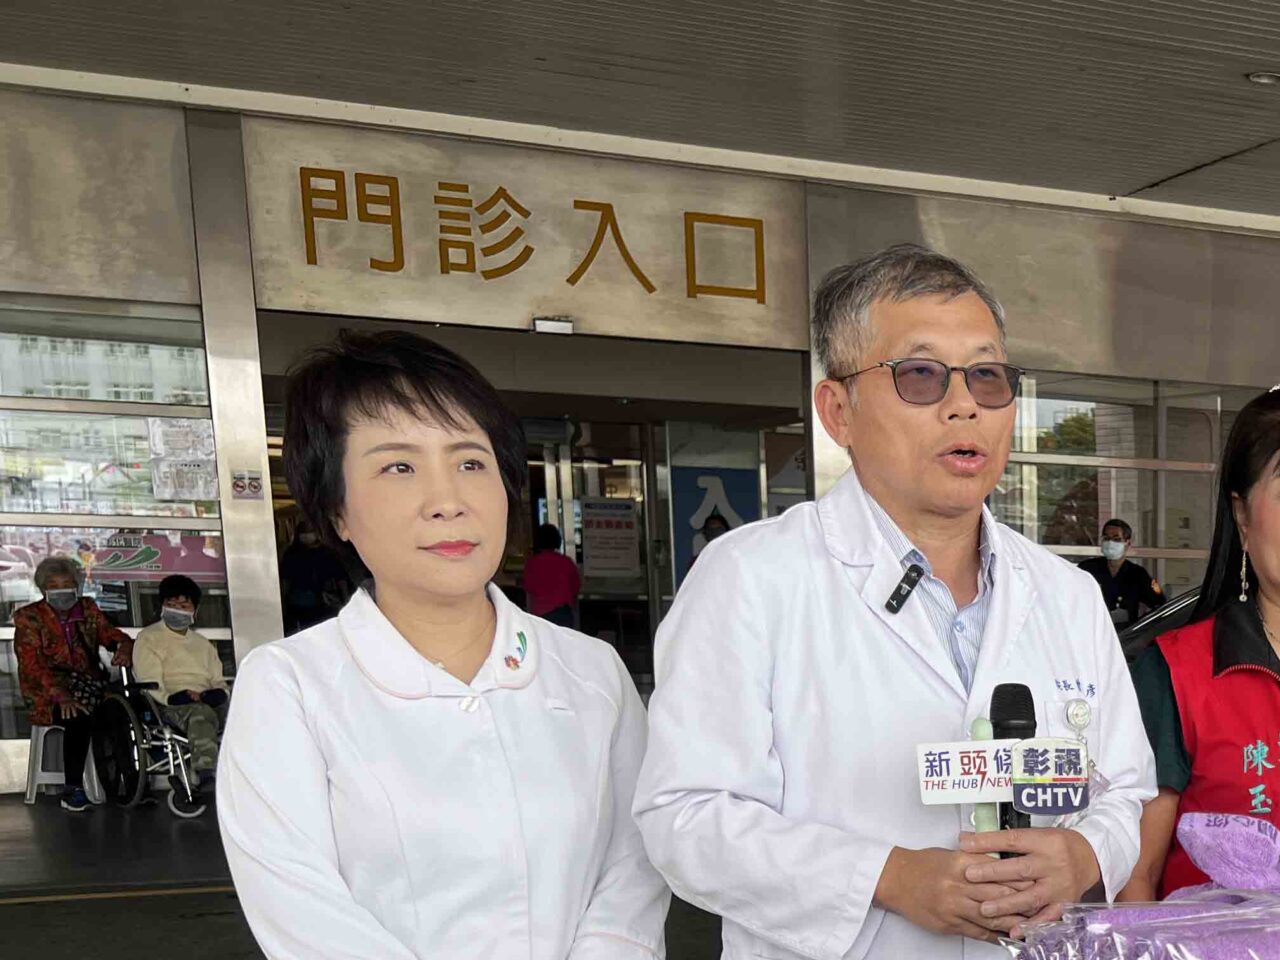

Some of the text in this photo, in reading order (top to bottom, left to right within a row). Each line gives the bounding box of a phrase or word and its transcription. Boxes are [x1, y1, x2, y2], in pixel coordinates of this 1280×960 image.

[299, 166, 768, 304] 門診入口
[1023, 747, 1083, 777] 彰視
[1243, 740, 1275, 814] 陳玉
[923, 776, 1012, 791] THE HUB NEW
[1021, 787, 1083, 808] CHTV
